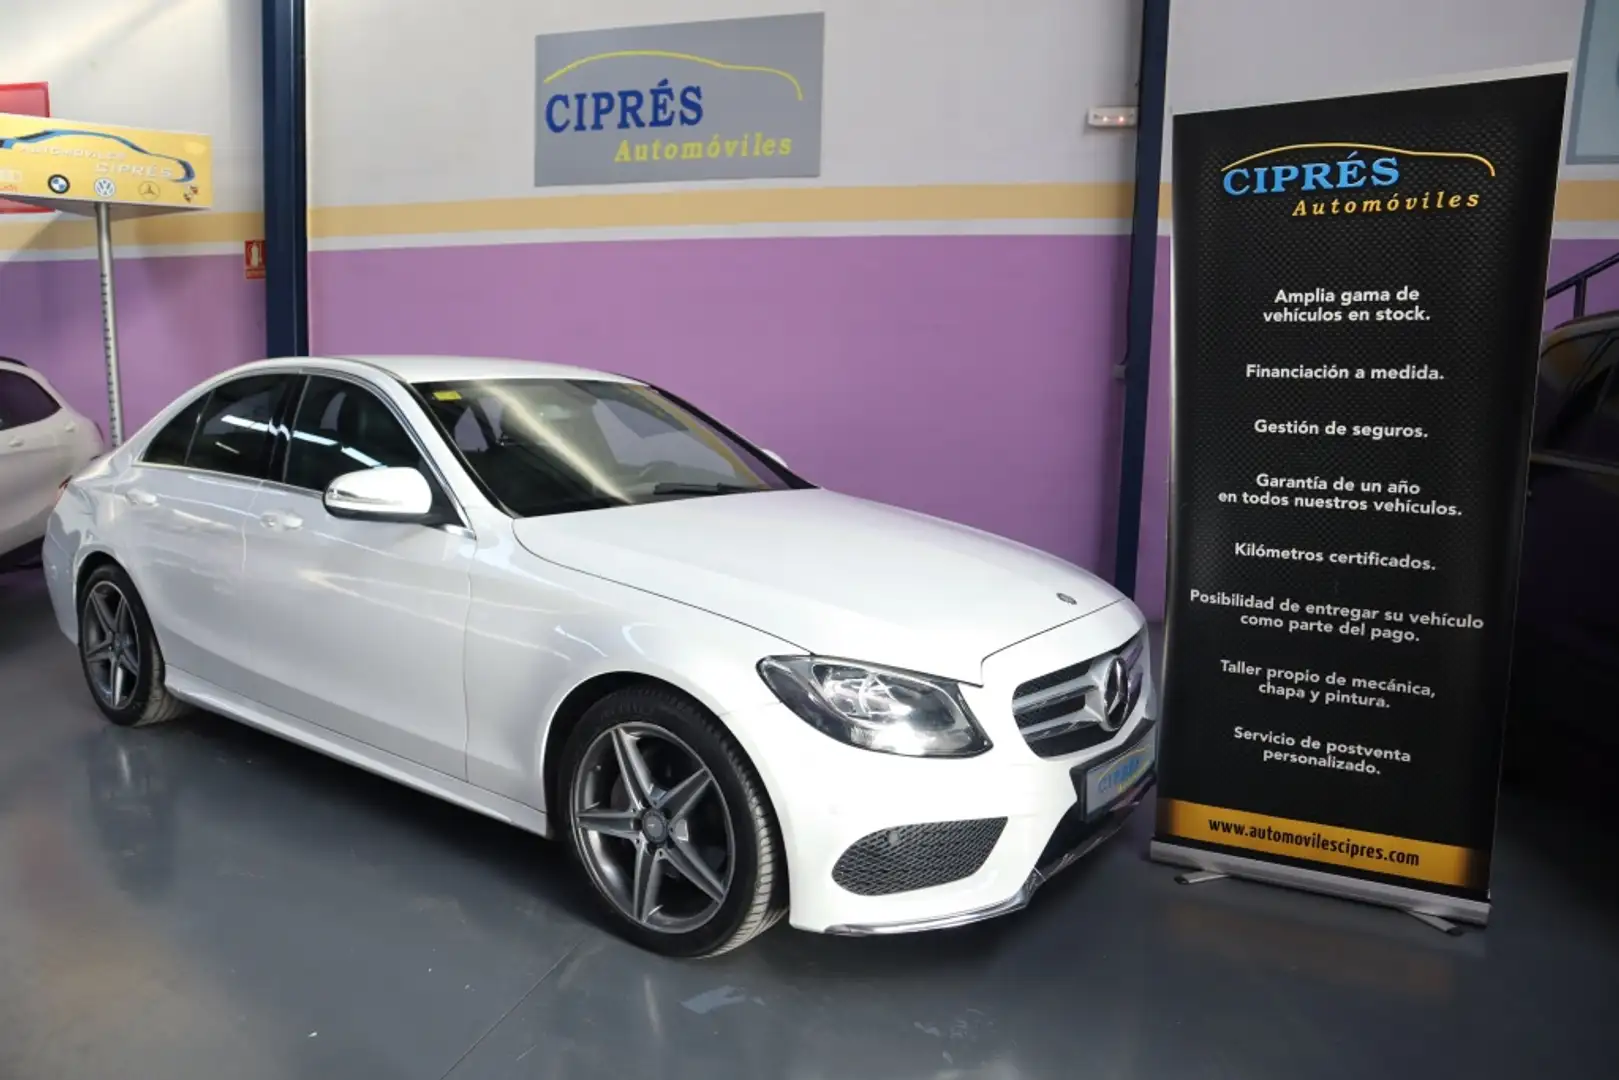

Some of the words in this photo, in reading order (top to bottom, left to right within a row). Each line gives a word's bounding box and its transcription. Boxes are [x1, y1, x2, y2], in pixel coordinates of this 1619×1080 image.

[546, 78, 703, 133] CIPRÉS
[614, 132, 792, 162] Automóviles
[1223, 151, 1400, 195] CIPRÉS
[1292, 192, 1480, 216] Automóviles
[1274, 289, 1335, 306] Amplia
[1341, 291, 1390, 306] gama
[1396, 286, 1419, 301] de
[1263, 307, 1342, 322] vehículos
[1349, 309, 1369, 321] en
[1376, 306, 1430, 321] stock.
[1246, 364, 1349, 379] Financiación
[1355, 368, 1365, 379] a
[1371, 364, 1444, 380] medida.
[1254, 419, 1319, 435] Gestión
[1325, 421, 1346, 435] de
[1353, 425, 1428, 439] seguros.
[1256, 473, 1327, 490] Garantía
[1333, 477, 1354, 491] de
[1361, 481, 1381, 493] un
[1388, 480, 1420, 494] año
[1218, 491, 1237, 502] en
[1242, 492, 1289, 506] todos
[1295, 496, 1367, 510] nuestros
[1374, 499, 1462, 516] vehículos.
[1235, 542, 1323, 562] Kilómetros
[1329, 551, 1436, 570] certificados.
[1190, 589, 1274, 610] Posibilidad
[1280, 598, 1300, 612] de
[1305, 603, 1379, 622] entregar
[1384, 610, 1403, 622] su
[1410, 612, 1484, 629] vehículo
[1240, 614, 1283, 628] como
[1289, 619, 1333, 633] parte
[1339, 621, 1365, 635] del
[1371, 627, 1420, 642] pago.
[1220, 659, 1261, 676] Taller
[1266, 667, 1320, 683] propio
[1326, 672, 1346, 686] de
[1352, 677, 1436, 698] mecánica,
[1258, 682, 1305, 699] chapa
[1310, 691, 1320, 703] y
[1325, 691, 1390, 708] pintura.
[1234, 726, 1295, 746] Servicio
[1300, 735, 1321, 749] de
[1326, 740, 1411, 762] postventa
[1263, 749, 1380, 775] personalizado.
[1208, 818, 1419, 866] www.automovilescipres.com
